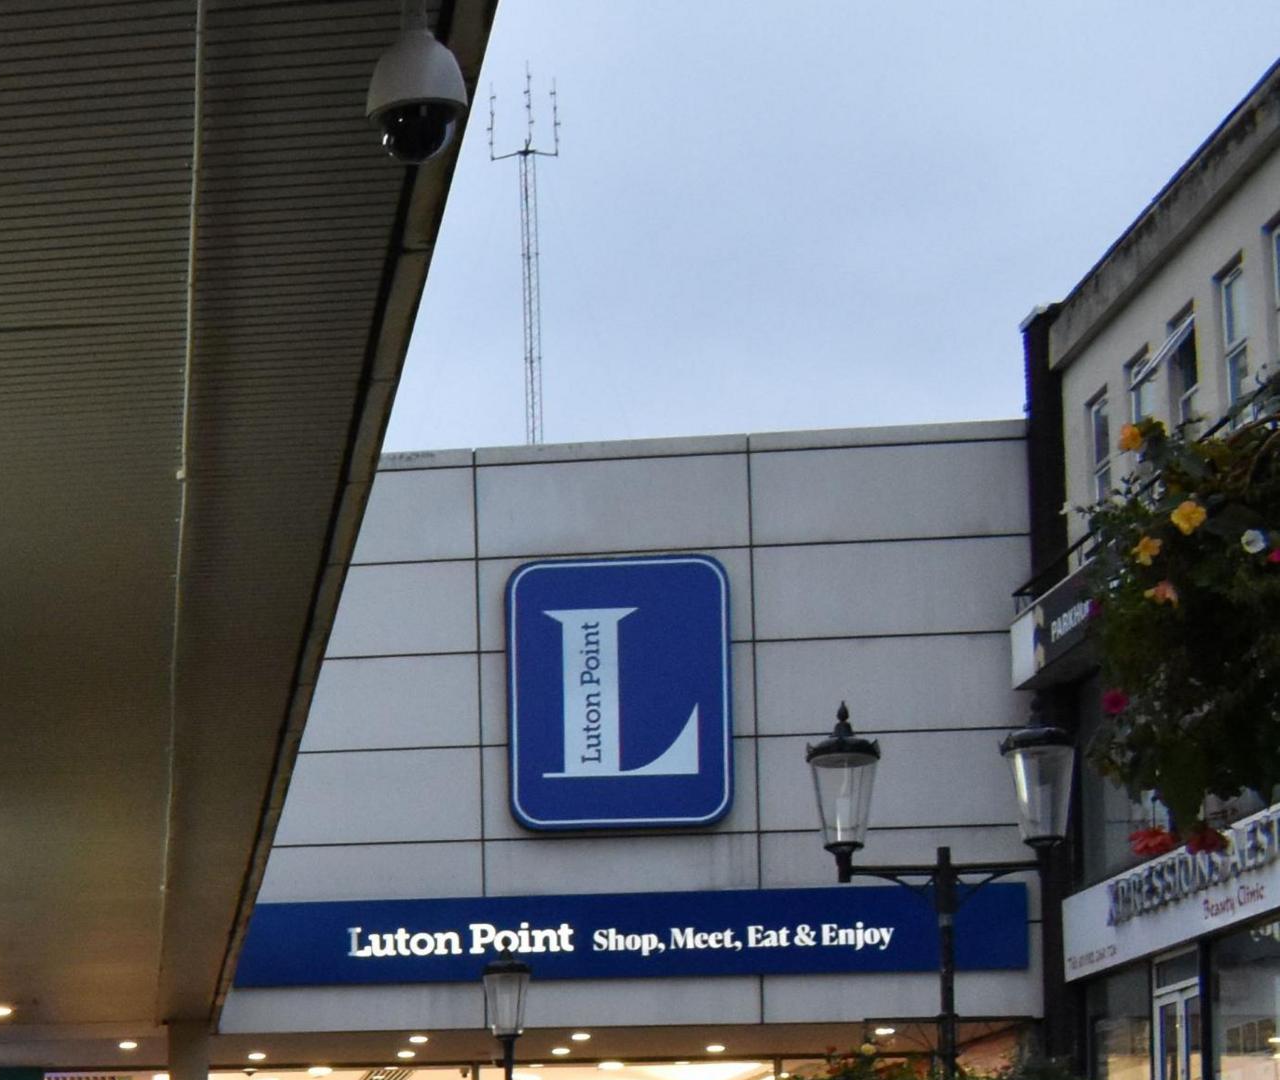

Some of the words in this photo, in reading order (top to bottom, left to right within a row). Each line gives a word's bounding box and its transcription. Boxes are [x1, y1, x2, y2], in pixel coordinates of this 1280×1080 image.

[580, 622, 601, 687] Point
[580, 692, 602, 764] Luton
[347, 926, 463, 957] Luton
[468, 921, 575, 955] Point
[592, 927, 665, 957] Shop,
[669, 926, 742, 952] Meet,
[746, 924, 791, 948] Eat
[792, 923, 816, 947] &
[820, 920, 895, 951] Enjoy
